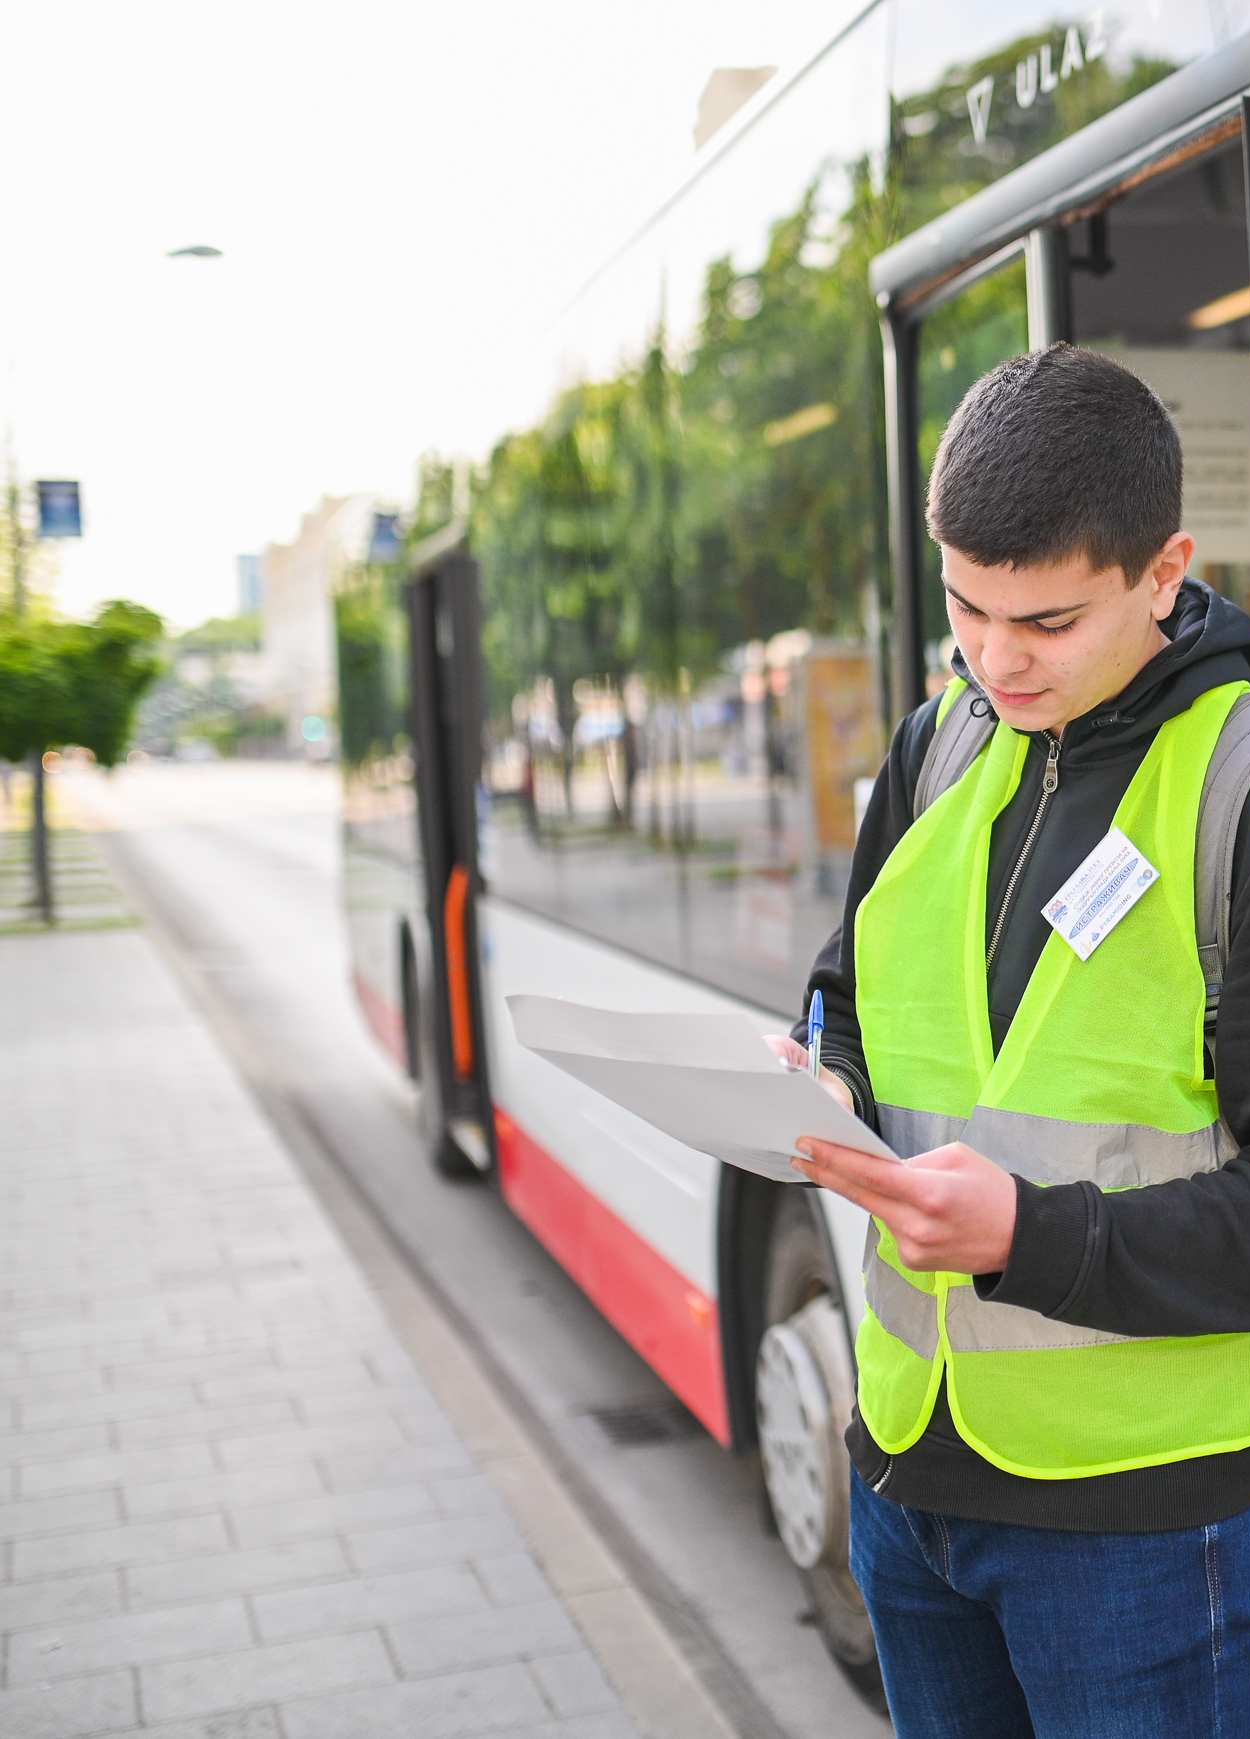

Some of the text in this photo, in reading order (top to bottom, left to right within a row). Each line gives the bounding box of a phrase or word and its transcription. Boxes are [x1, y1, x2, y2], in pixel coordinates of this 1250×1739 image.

[1121, 846, 1128, 854] НА
[1075, 866, 1132, 931] ИСТРАЖИВАЧ
[1100, 894, 1132, 931] PYRAMIDING
